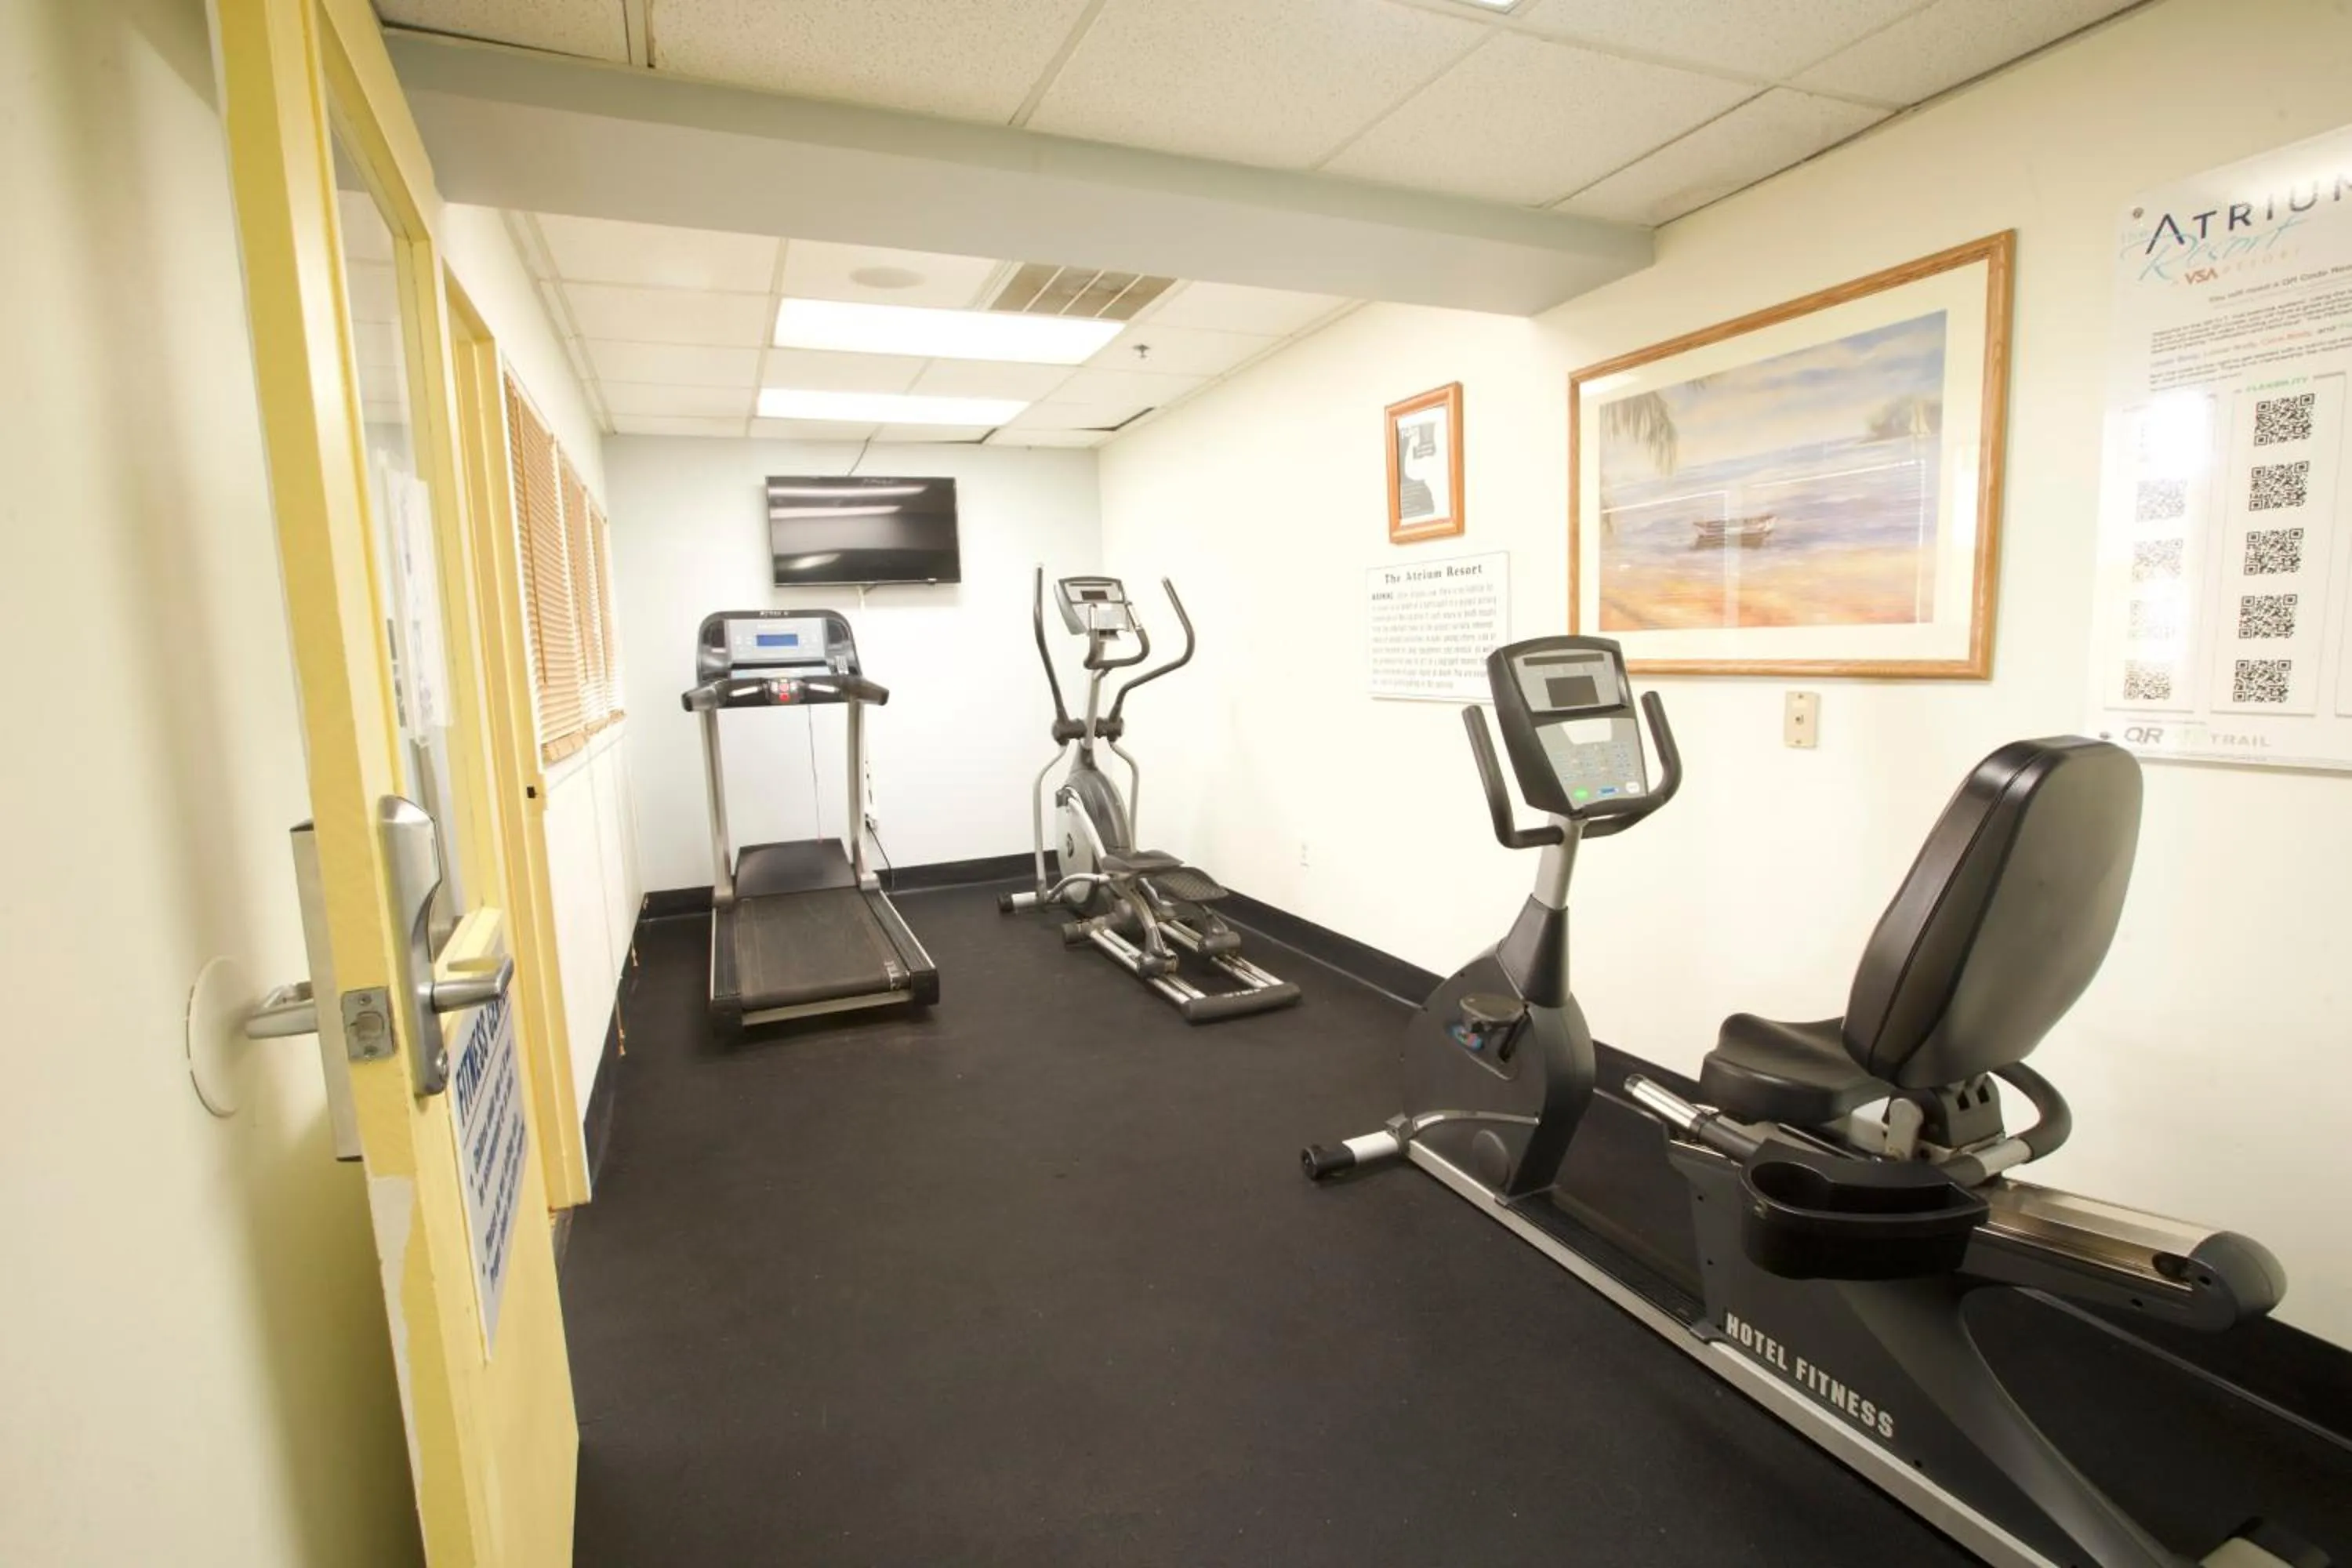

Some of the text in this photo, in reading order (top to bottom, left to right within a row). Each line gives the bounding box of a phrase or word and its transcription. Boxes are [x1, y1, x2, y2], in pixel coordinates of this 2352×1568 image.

[2184, 267, 2219, 285] VSA
[1385, 564, 1482, 584] The Atrium Resort
[2123, 726, 2165, 745] QR
[2209, 732, 2272, 748] TRAIL
[1726, 1312, 1895, 1439] HOTEL FITNESS
